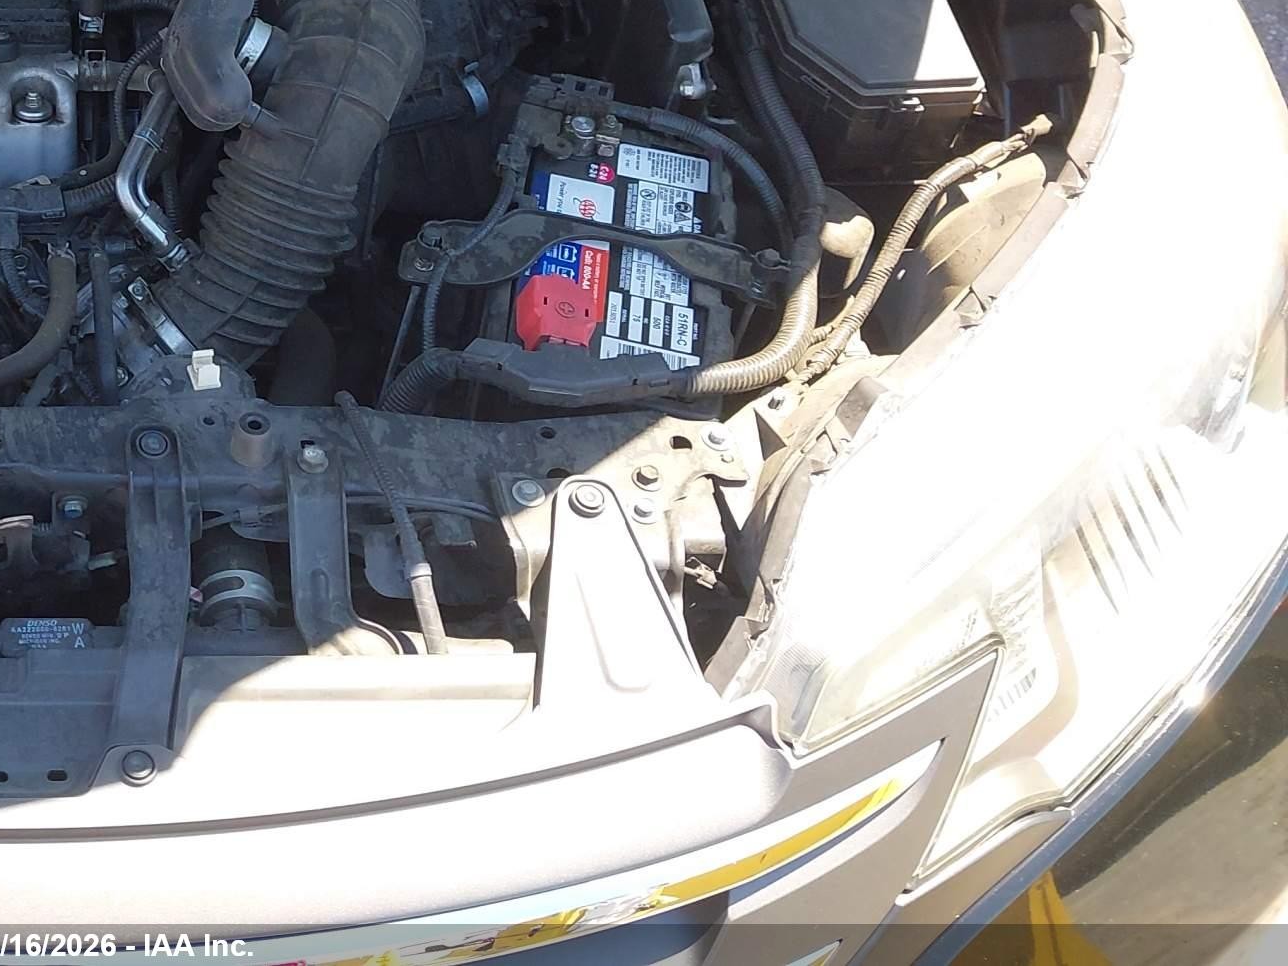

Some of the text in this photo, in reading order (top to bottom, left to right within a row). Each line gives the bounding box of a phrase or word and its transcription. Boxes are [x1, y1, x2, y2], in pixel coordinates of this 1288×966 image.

[677, 313, 689, 346] 51RN-C
[72, 622, 84, 635] W
[74, 636, 86, 648] A
